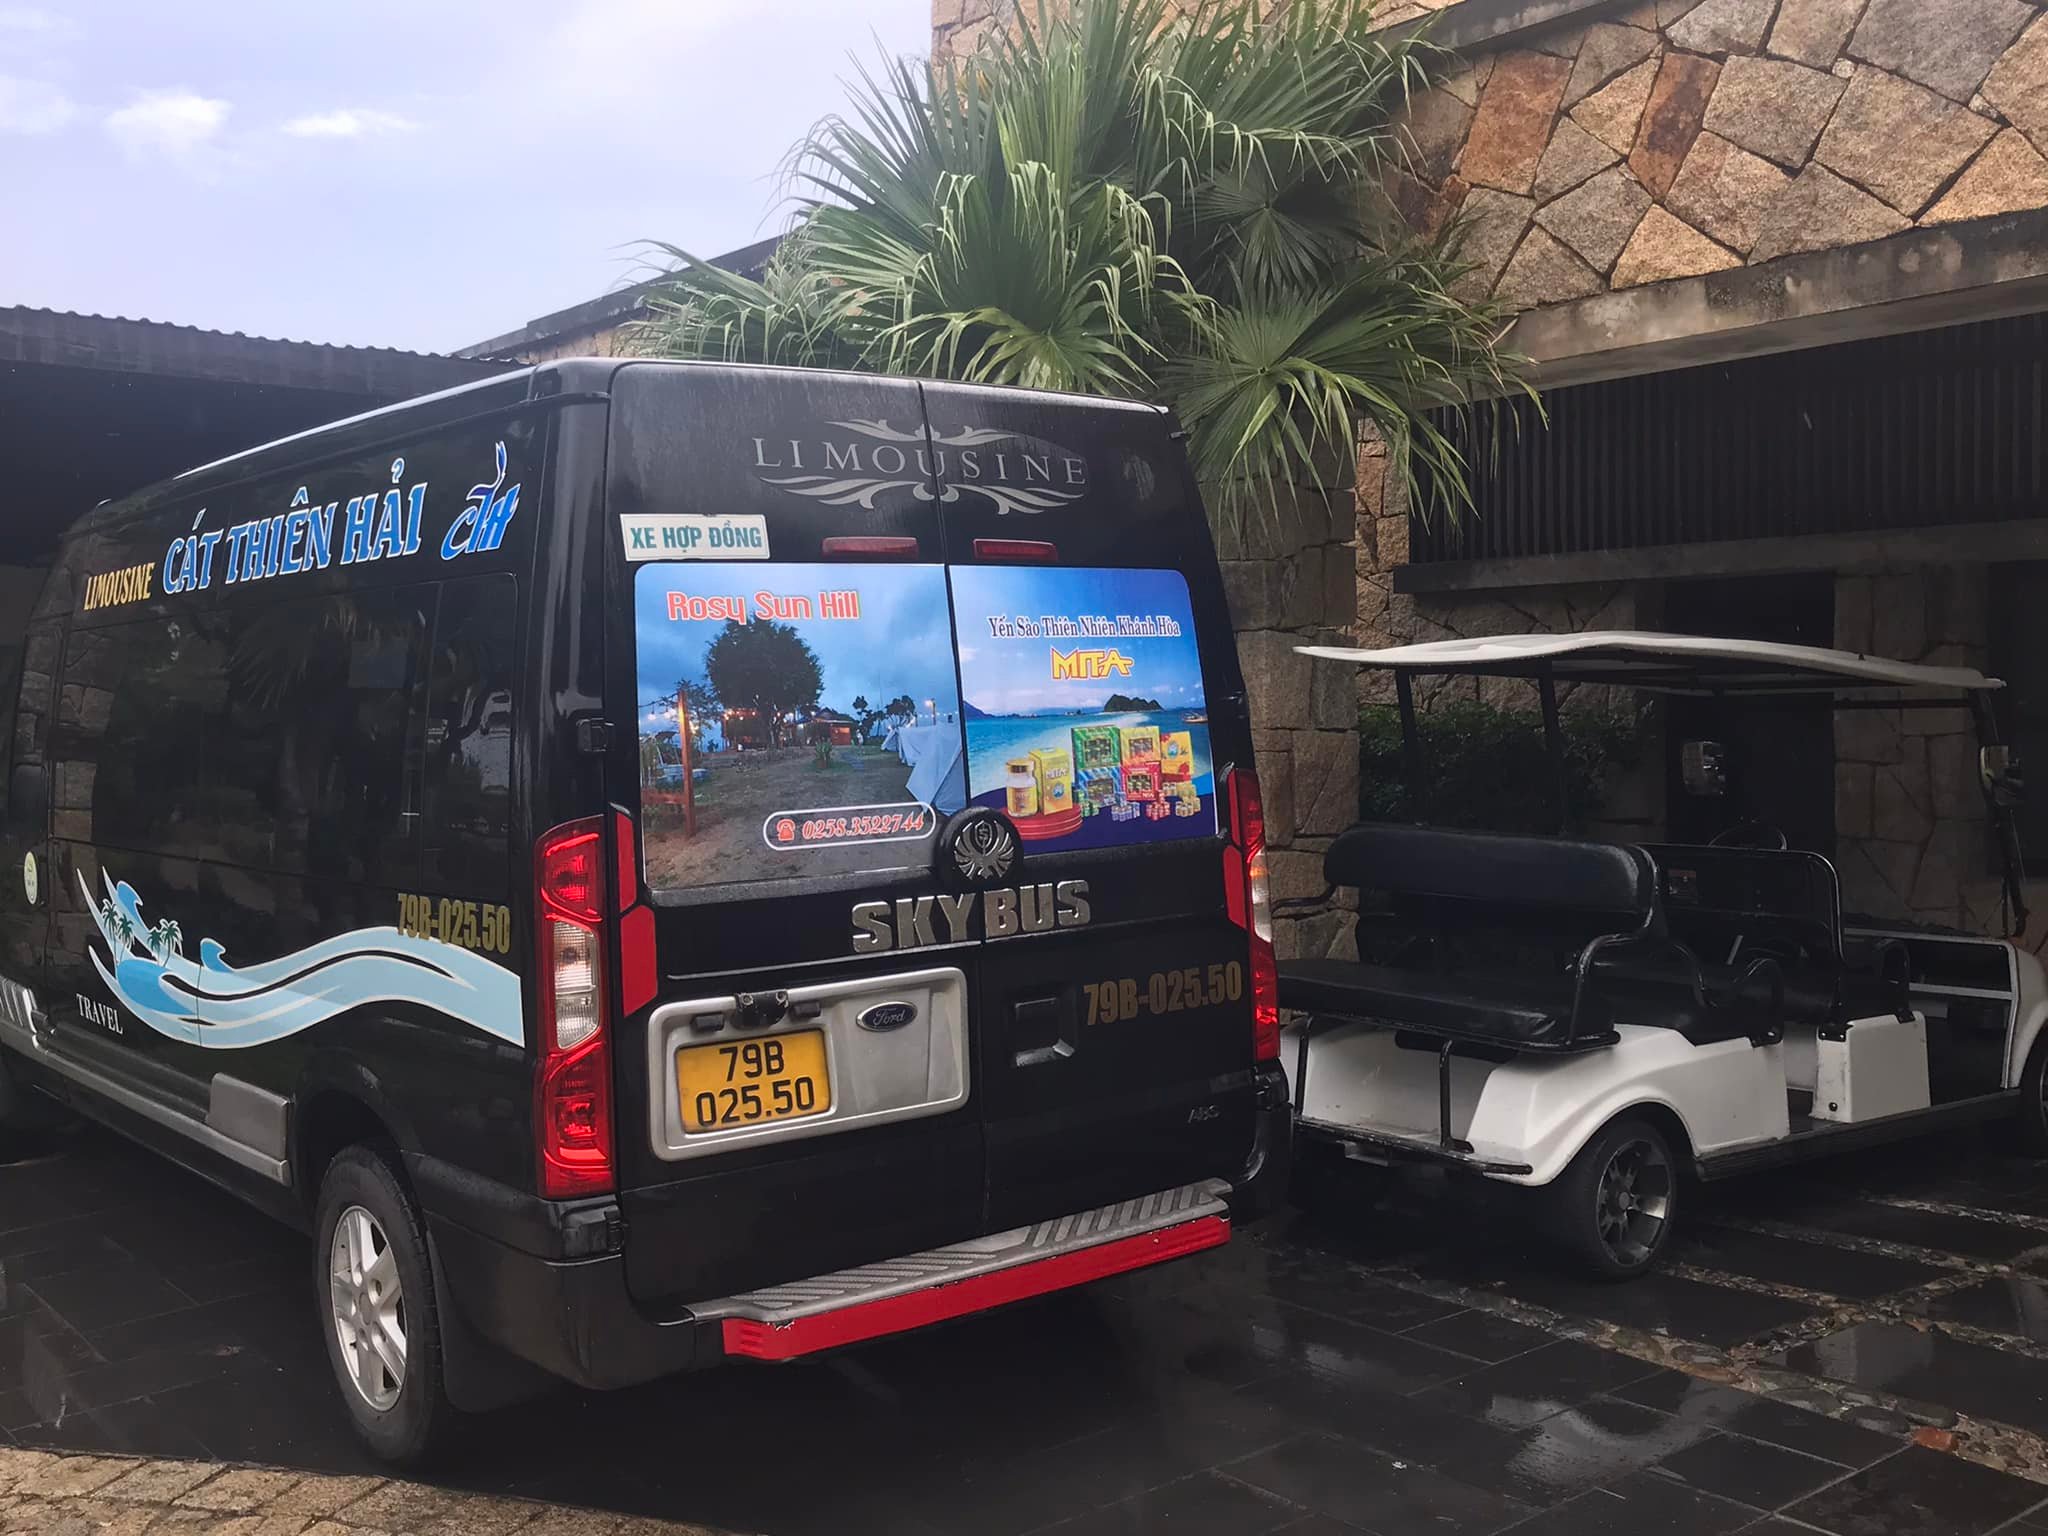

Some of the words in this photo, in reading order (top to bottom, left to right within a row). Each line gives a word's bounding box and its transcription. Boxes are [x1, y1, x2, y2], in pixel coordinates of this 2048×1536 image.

[753, 437, 1086, 485] LIMOUSINE
[84, 562, 156, 611] LIMOUSINE
[162, 507, 225, 595] CÁT
[225, 486, 340, 585] THIÊN
[340, 457, 429, 566] HẢI
[630, 527, 657, 549] XE
[662, 525, 702, 553] HỢP
[666, 591, 748, 626] Rosy
[754, 591, 812, 622] Sun
[819, 590, 860, 620] Hill
[988, 614, 1015, 638] Yến
[1016, 615, 1041, 637] Sào
[1042, 615, 1078, 638] Thiên
[1080, 615, 1117, 637] Nhiên
[1118, 614, 1156, 636] Khánh
[802, 811, 925, 840] 0258.3522744
[397, 892, 511, 954] 79B-025.50
[851, 892, 976, 953] SKY
[983, 879, 1091, 938] BUS
[76, 993, 123, 1034] TRAVEL
[1083, 960, 1242, 1026] 79B-025.50
[872, 1009, 906, 1027] Ford
[719, 1040, 785, 1082] 79B
[695, 1076, 815, 1128] 025.50
